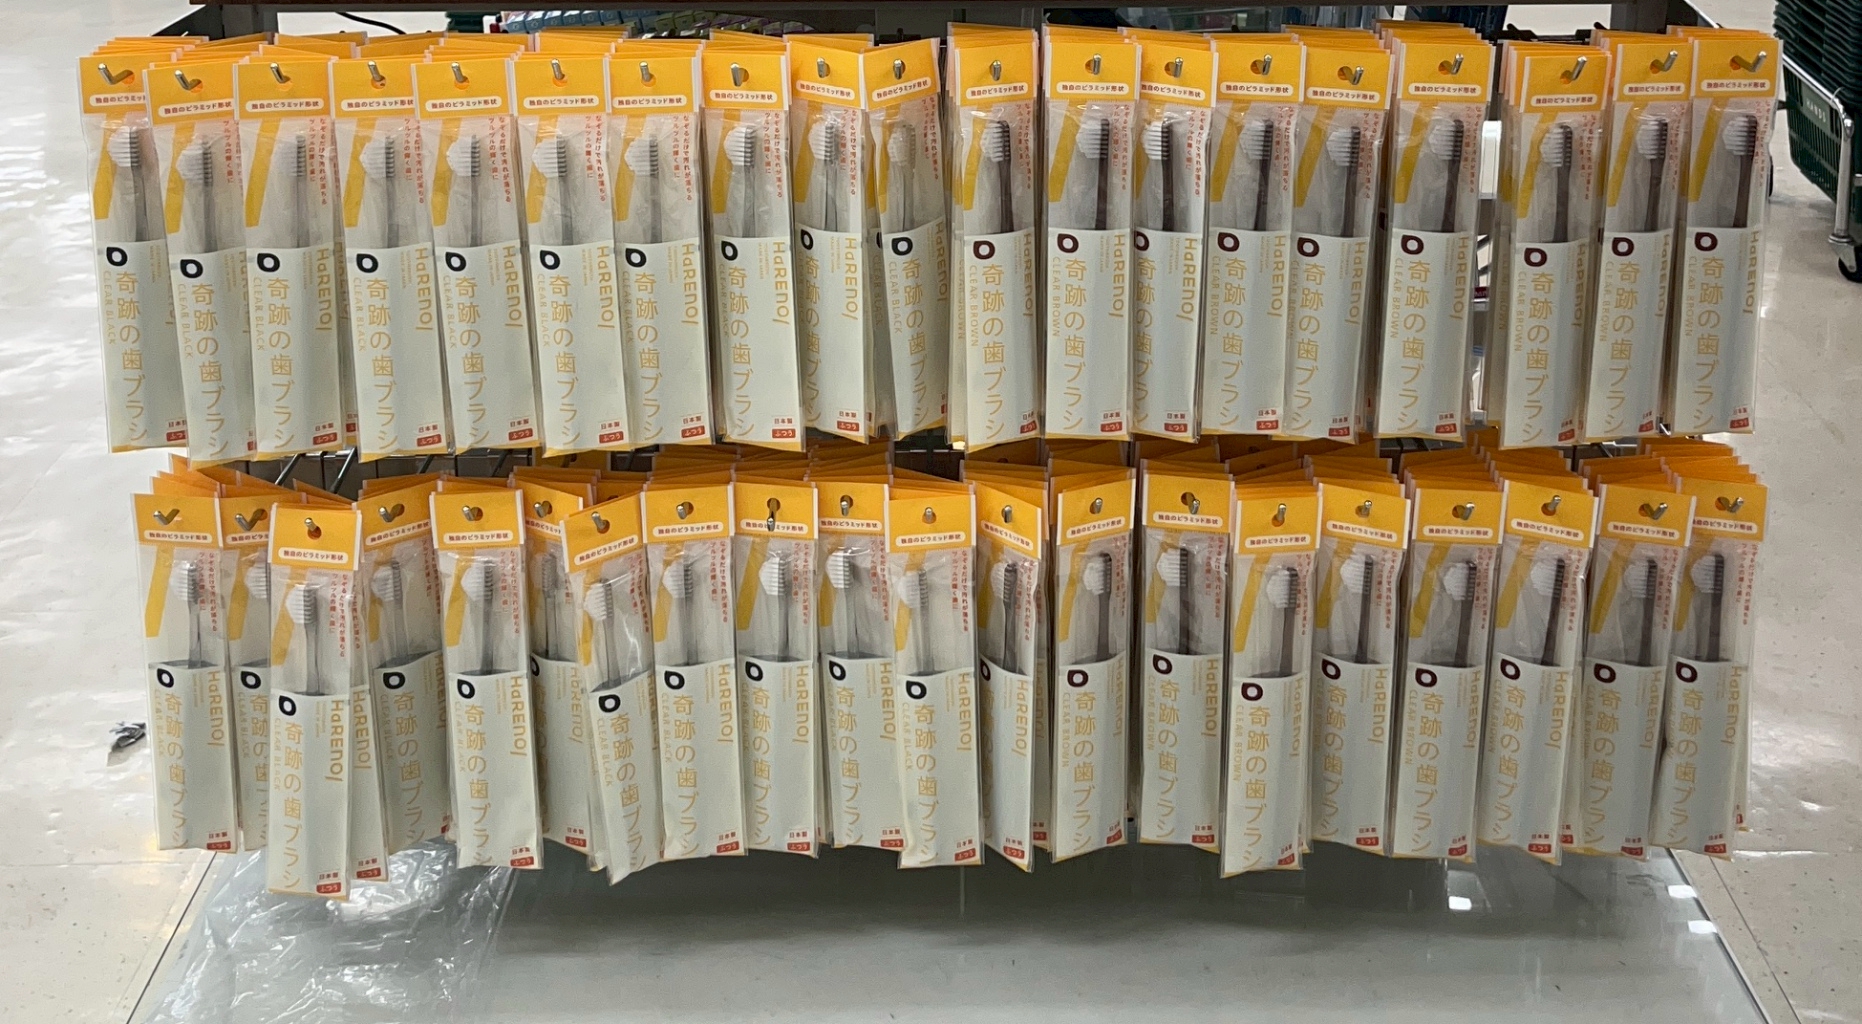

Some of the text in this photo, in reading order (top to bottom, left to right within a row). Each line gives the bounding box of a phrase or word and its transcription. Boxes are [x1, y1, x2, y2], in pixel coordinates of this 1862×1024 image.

[116, 272, 148, 442] 奇跡の歯ブラシ
[267, 278, 296, 450] 奇跡の歯ブラシ
[455, 278, 491, 445] 奇跡の歯ブラシ
[549, 276, 580, 446] 奇跡の歯ブラシ
[634, 272, 663, 441] 奇跡の歯ブラシ
[729, 265, 755, 438] 奇跡の歯ブラシ
[902, 258, 931, 421] 奇跡の歯ブラシ
[982, 264, 1006, 440] 奇跡の歯ブラシ
[1063, 258, 1087, 432] 奇跡の歯ブラシ
[1221, 258, 1248, 427] 奇跡の歯ブラシ
[1294, 262, 1325, 431] 奇跡の歯ブラシ
[1397, 260, 1432, 433] 奇跡の歯ブラシ
[1522, 272, 1555, 444] 奇跡の歯ブラシ
[1694, 257, 1725, 431] 奇跡の歯ブラシ
[165, 693, 187, 849] 奇跡の歯ブラシ
[464, 703, 493, 865] 奇跡の歯ブラシ
[673, 695, 700, 857] 奇跡の歯ブラシ
[752, 686, 772, 846] 奇跡の歯ブラシ
[915, 703, 940, 864] 奇跡の歯ブラシ
[1072, 690, 1097, 854] 奇跡の歯ブラシ
[1156, 681, 1181, 840] 奇跡の歯ブラシ
[1411, 691, 1444, 854] 奇跡の歯ブラシ
[1667, 688, 1703, 847] 奇跡の歯ブラシ
